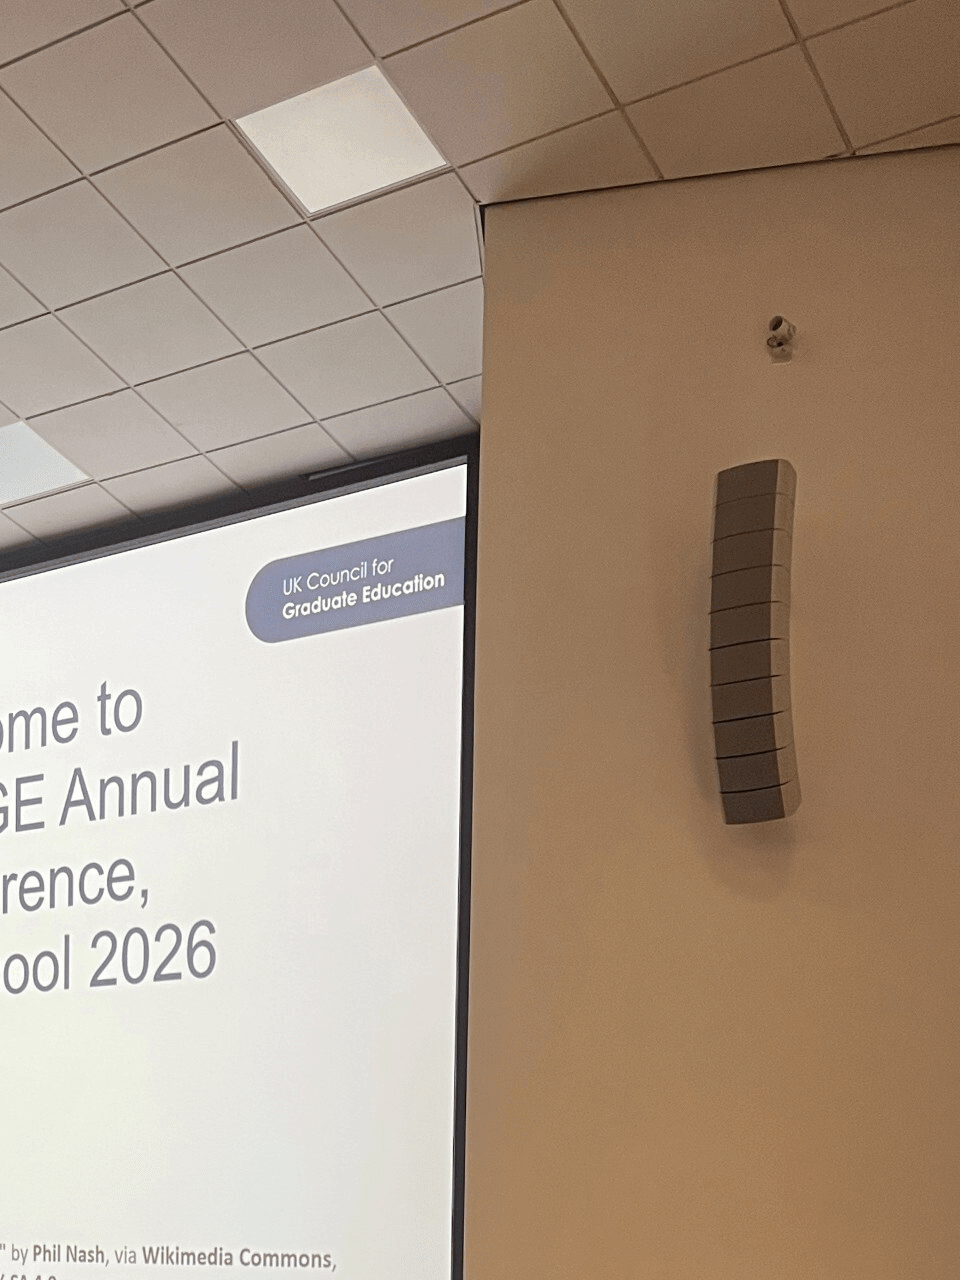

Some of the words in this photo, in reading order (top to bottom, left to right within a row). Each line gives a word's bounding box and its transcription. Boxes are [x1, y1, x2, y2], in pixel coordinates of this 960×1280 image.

[282, 590, 358, 620] Graduate
[362, 573, 445, 603] Education
[283, 575, 302, 595] UK
[306, 561, 367, 590] Council
[372, 558, 394, 577] for
[97, 680, 143, 736] to
[59, 740, 239, 826] Annual
[90, 919, 217, 988] 2026
[12, 1243, 28, 1266] by
[33, 1244, 61, 1262] Phil
[66, 1245, 109, 1267] Nash,
[115, 1245, 137, 1264] via
[142, 1246, 233, 1266] Wikimedia
[239, 1248, 337, 1272] Commons,
